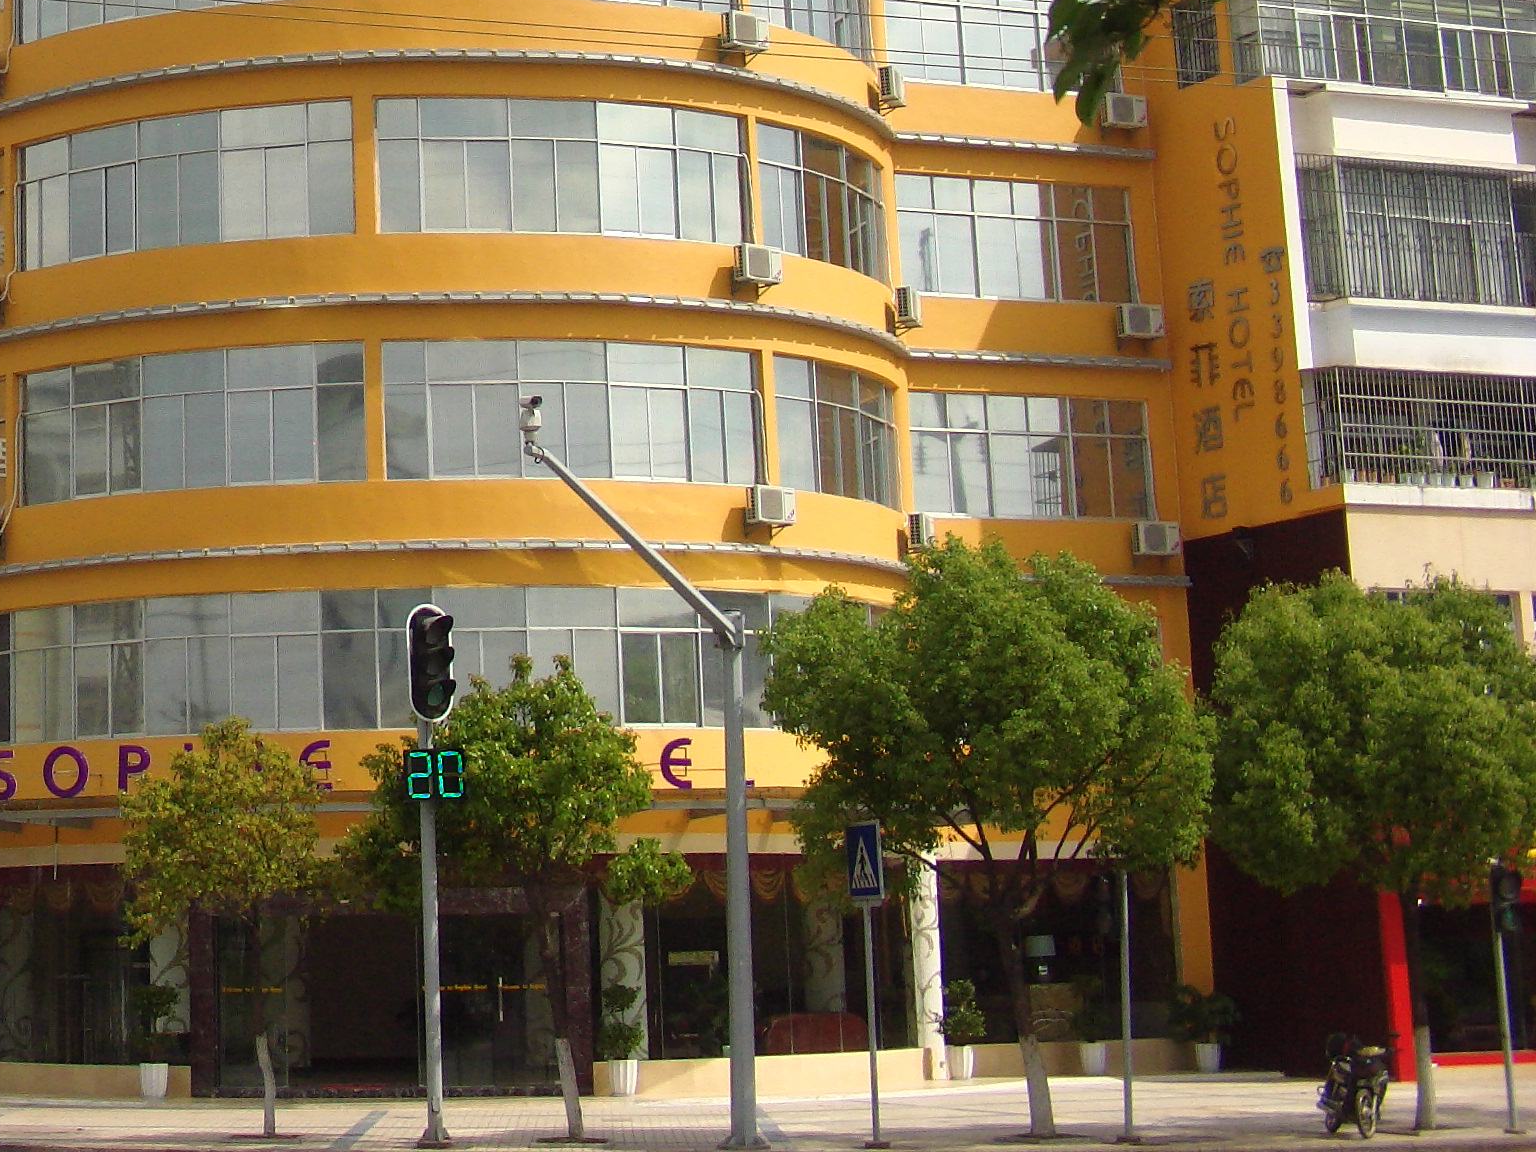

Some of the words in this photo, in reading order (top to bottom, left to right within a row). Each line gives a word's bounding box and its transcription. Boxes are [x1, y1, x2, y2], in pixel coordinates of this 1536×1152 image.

[1214, 116, 1246, 266] SOPHIE
[1187, 276, 1229, 521] 索菲酒店
[1226, 286, 1256, 423] HOTEL
[1267, 277, 1294, 506] 3398666
[408, 750, 464, 800] 20
